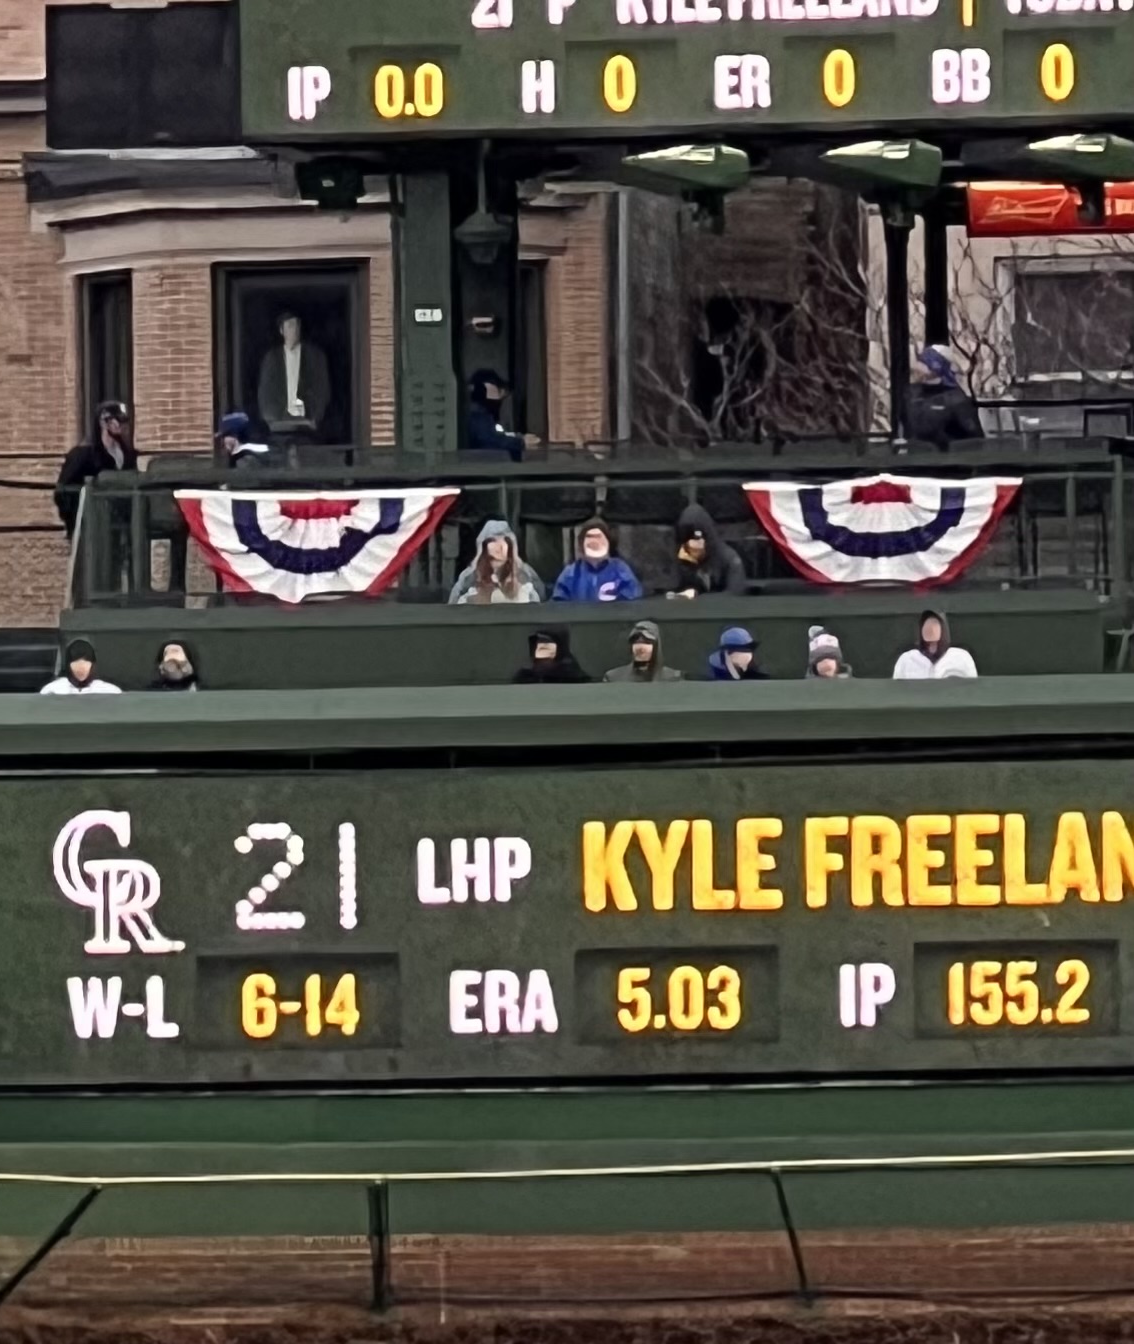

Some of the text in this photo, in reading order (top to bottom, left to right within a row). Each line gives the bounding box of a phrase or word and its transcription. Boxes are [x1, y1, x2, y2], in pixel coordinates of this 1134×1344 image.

[287, 43, 1075, 120] IP 0.0 H 0 ER 0 BB 0
[233, 822, 358, 930] 21
[416, 836, 532, 904] LHP
[582, 817, 784, 912] KYLE
[66, 960, 1091, 1038] W-L 6-14 ERA 5.03 IP 155.2
